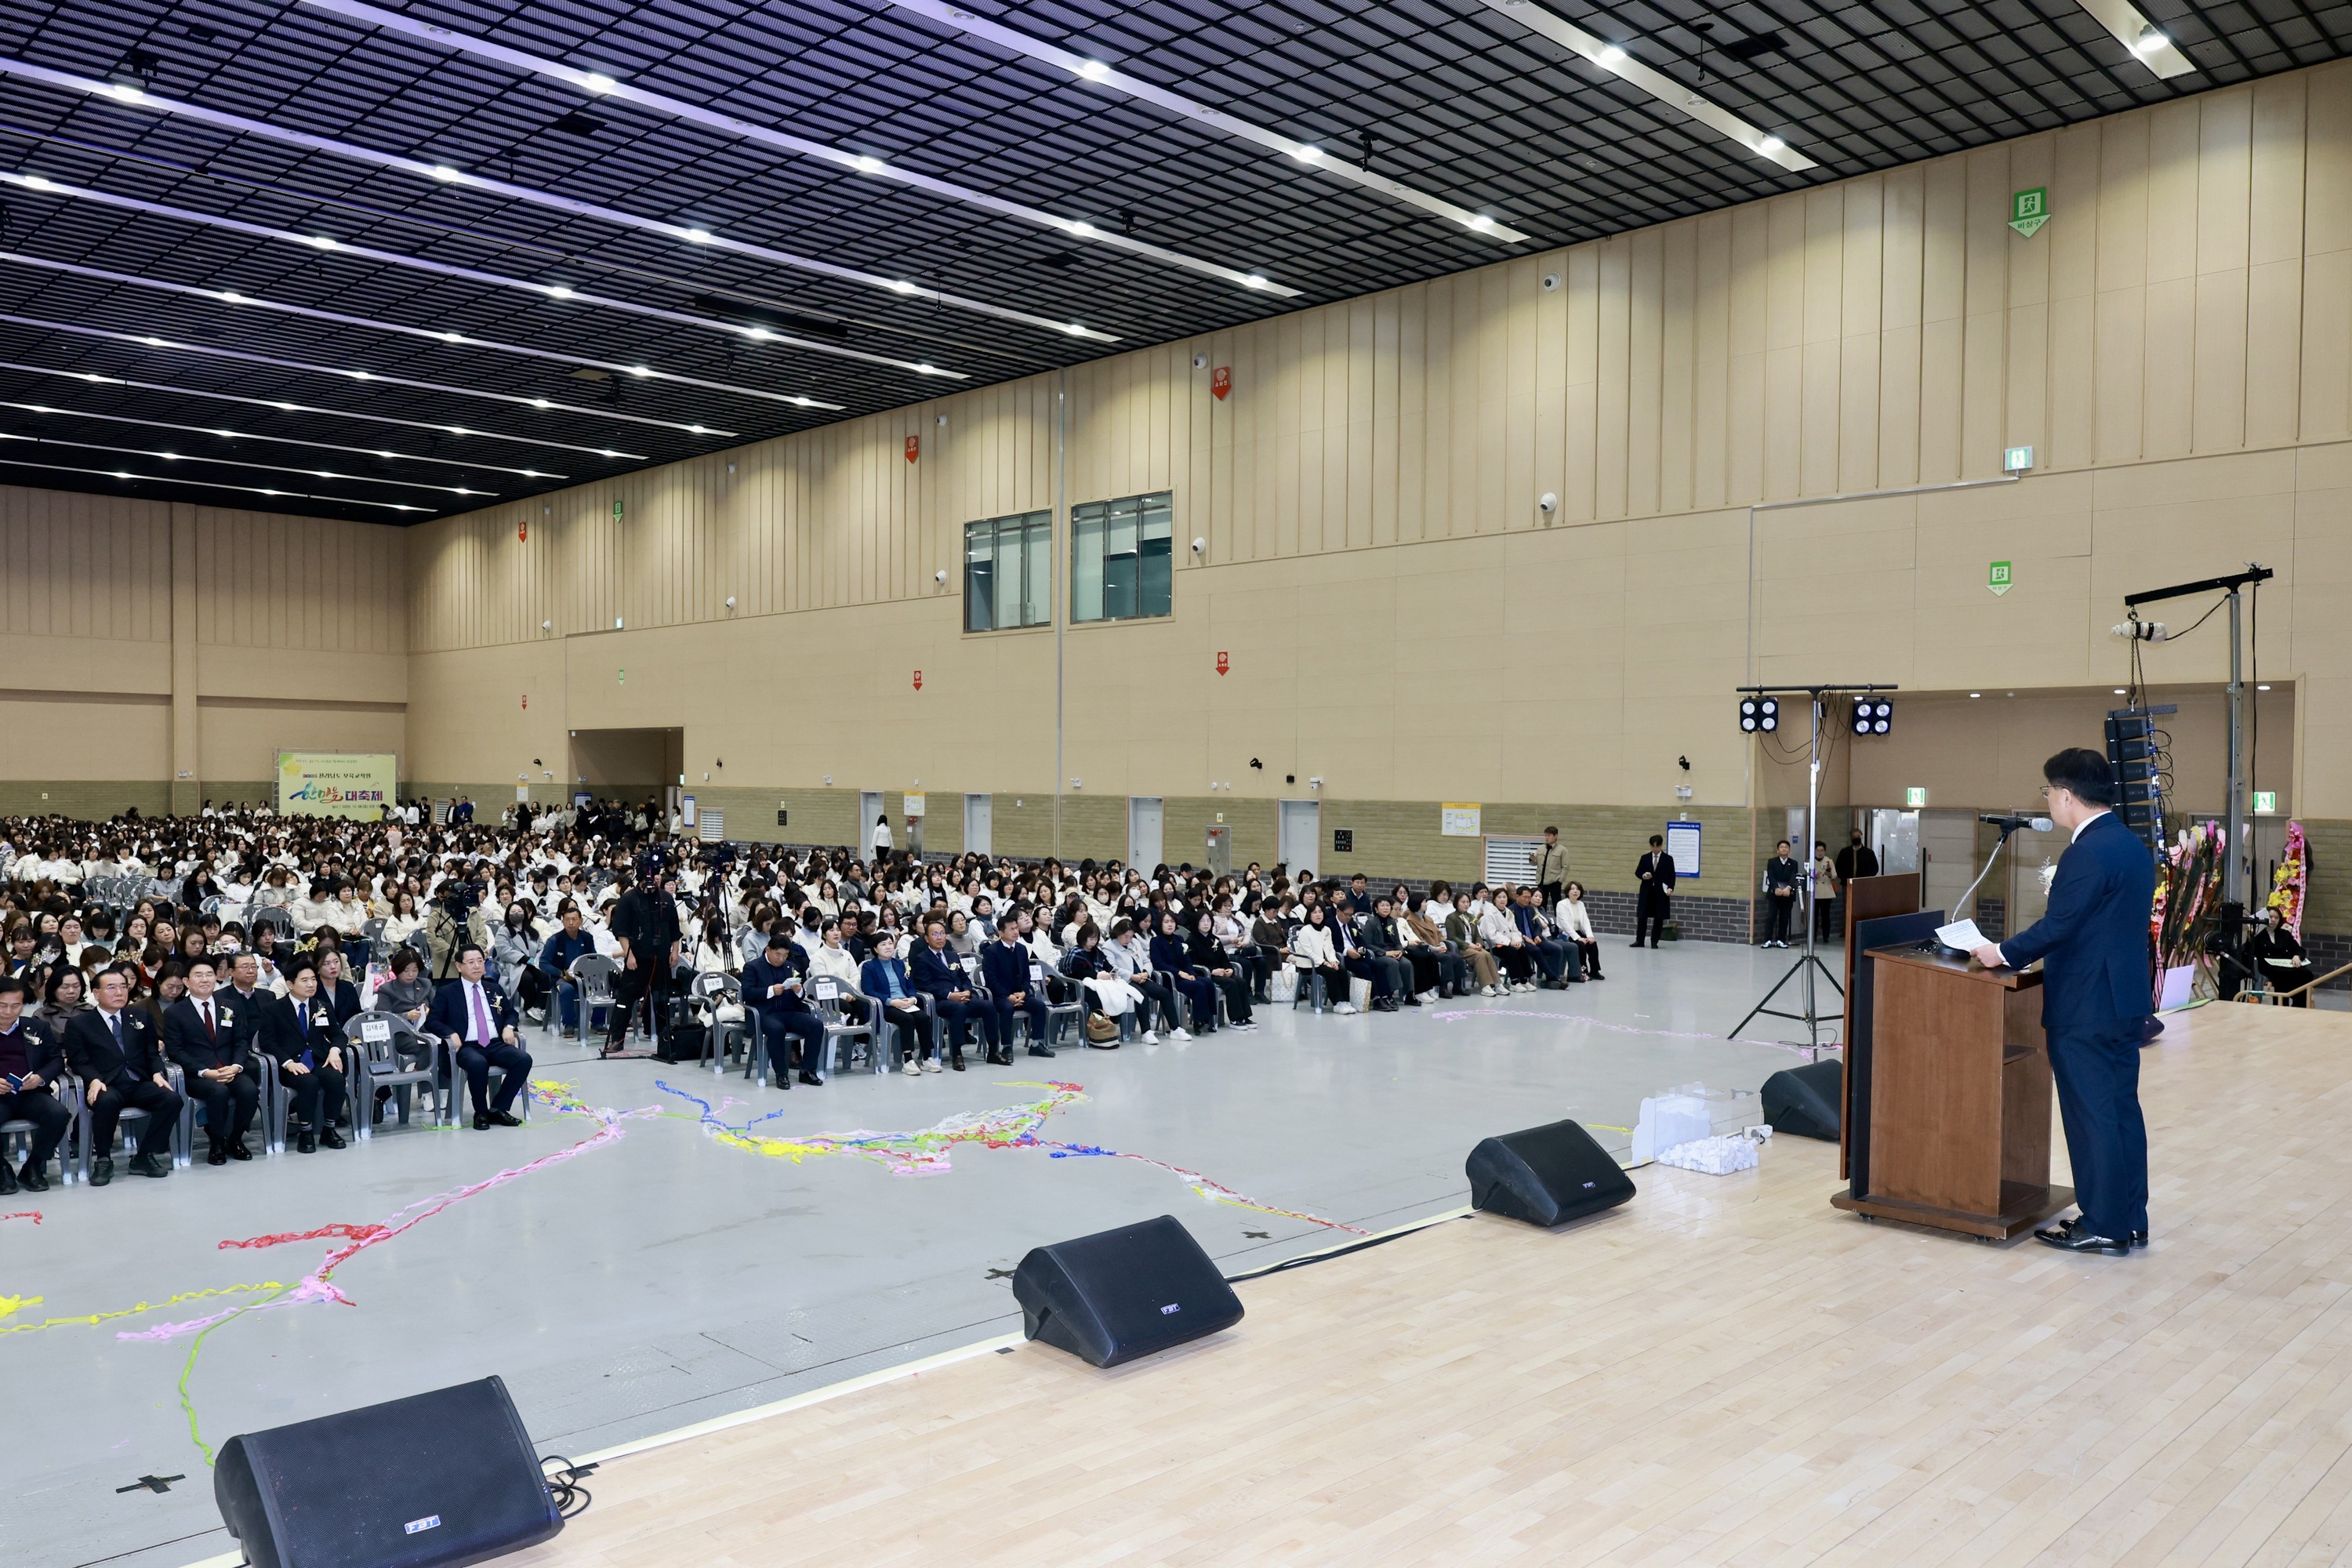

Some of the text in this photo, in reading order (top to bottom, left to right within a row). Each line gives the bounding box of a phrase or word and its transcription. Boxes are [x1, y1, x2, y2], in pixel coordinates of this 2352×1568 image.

[2017, 219, 2042, 229] 비상구
[289, 781, 383, 804] 한마음 대축제
[365, 1022, 385, 1032] 김태균
[407, 1517, 437, 1533] FBT
